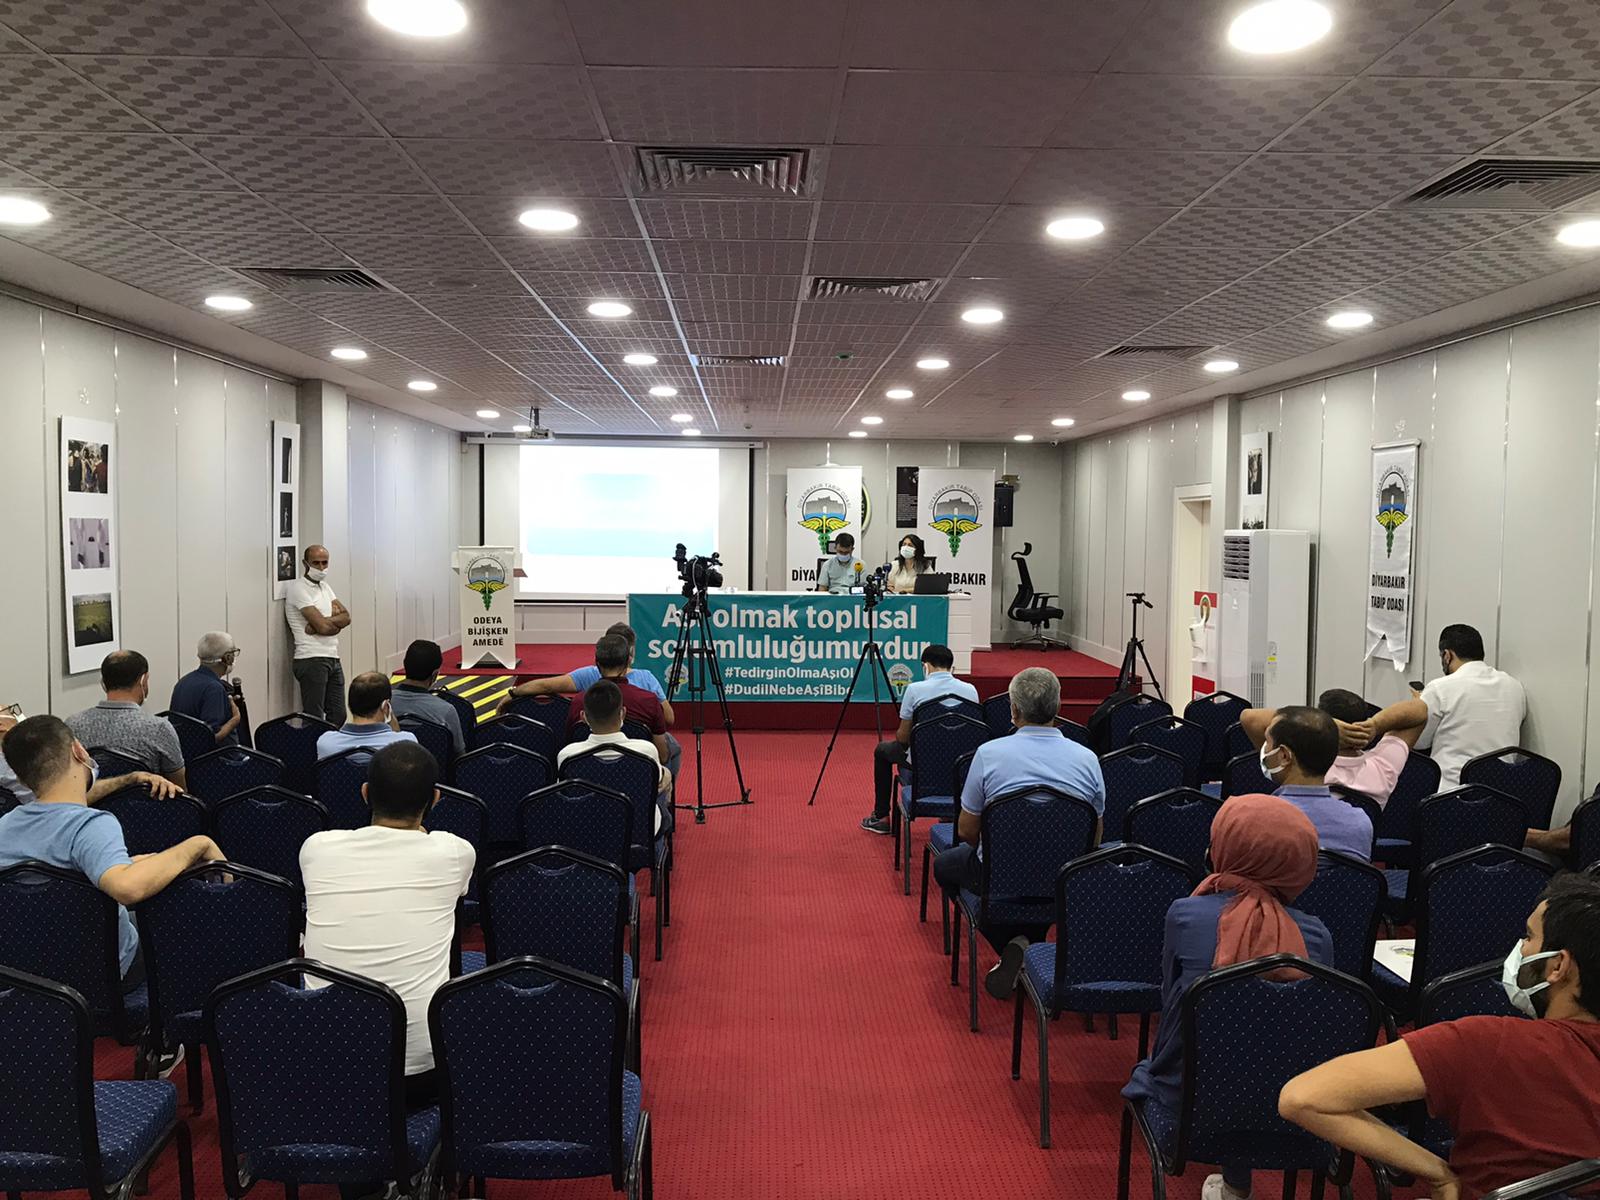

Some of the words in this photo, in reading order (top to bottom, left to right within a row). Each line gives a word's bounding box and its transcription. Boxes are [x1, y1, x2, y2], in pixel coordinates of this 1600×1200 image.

[1372, 572, 1406, 589] DİYARBAKIR
[1371, 594, 1386, 609] TABİP
[1386, 597, 1405, 612] ODASI
[473, 616, 503, 625] ODEYA
[712, 603, 799, 628] olmak
[806, 604, 917, 633] toplusal
